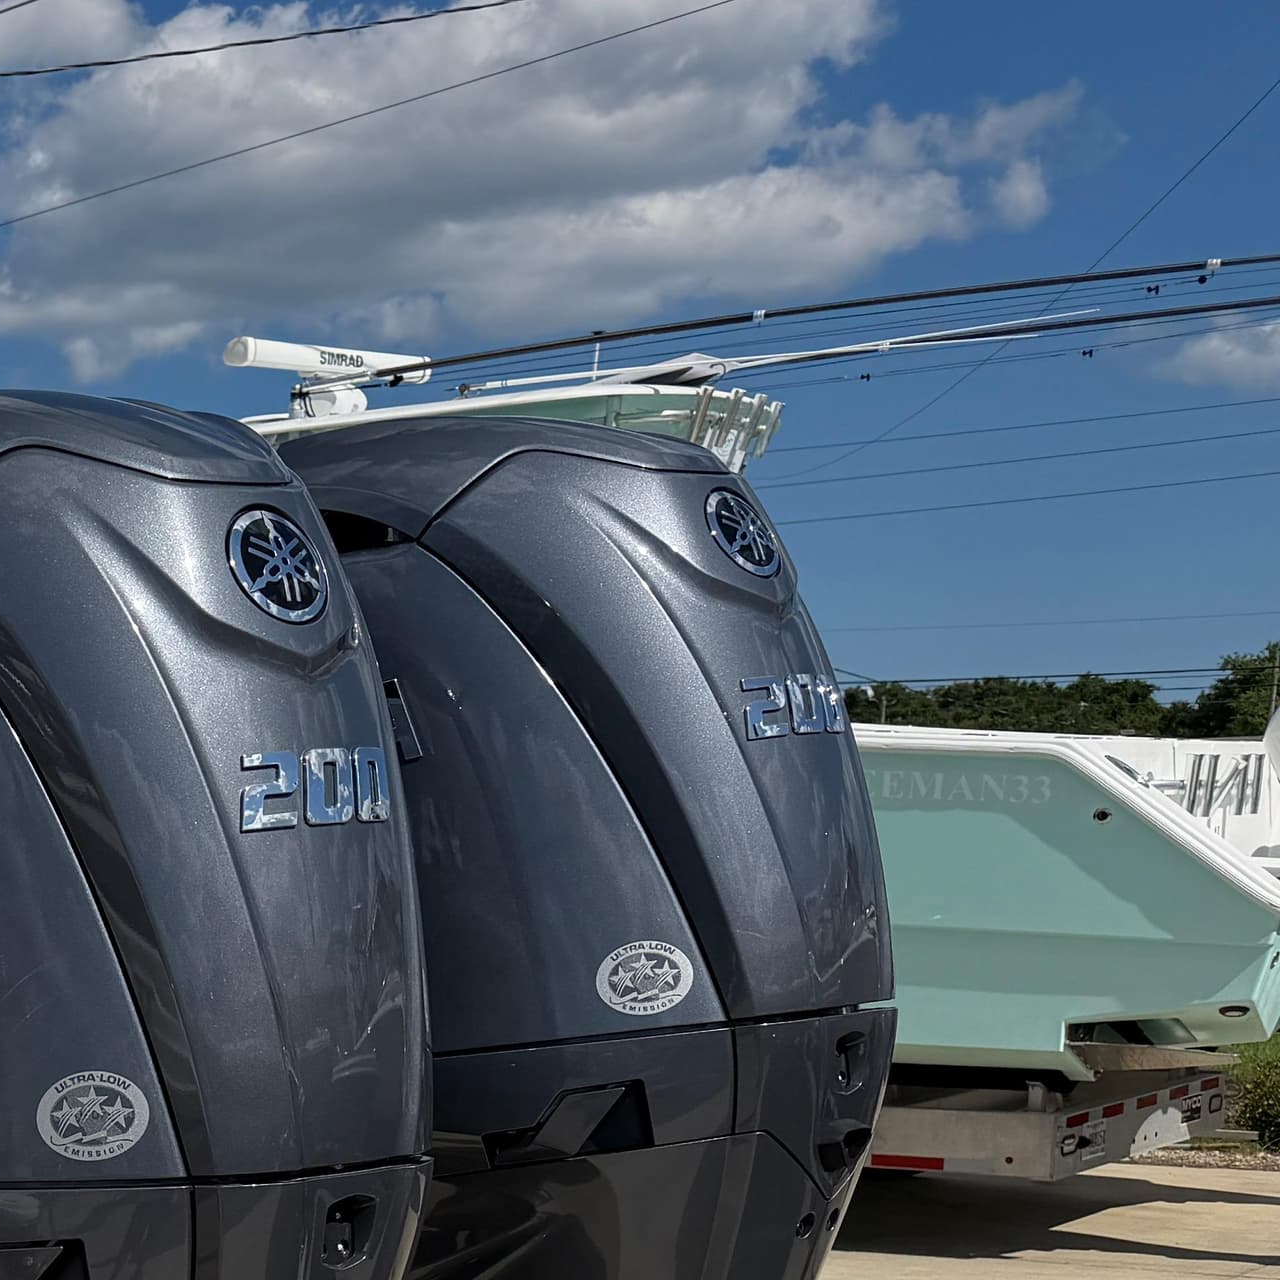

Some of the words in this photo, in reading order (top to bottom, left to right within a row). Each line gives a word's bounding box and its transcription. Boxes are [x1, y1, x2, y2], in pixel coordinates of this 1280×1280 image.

[319, 351, 364, 368] SIMRAD
[239, 746, 390, 834] 200
[621, 997, 675, 1013] EMISSION
[63, 1143, 124, 1158] EMISSION
